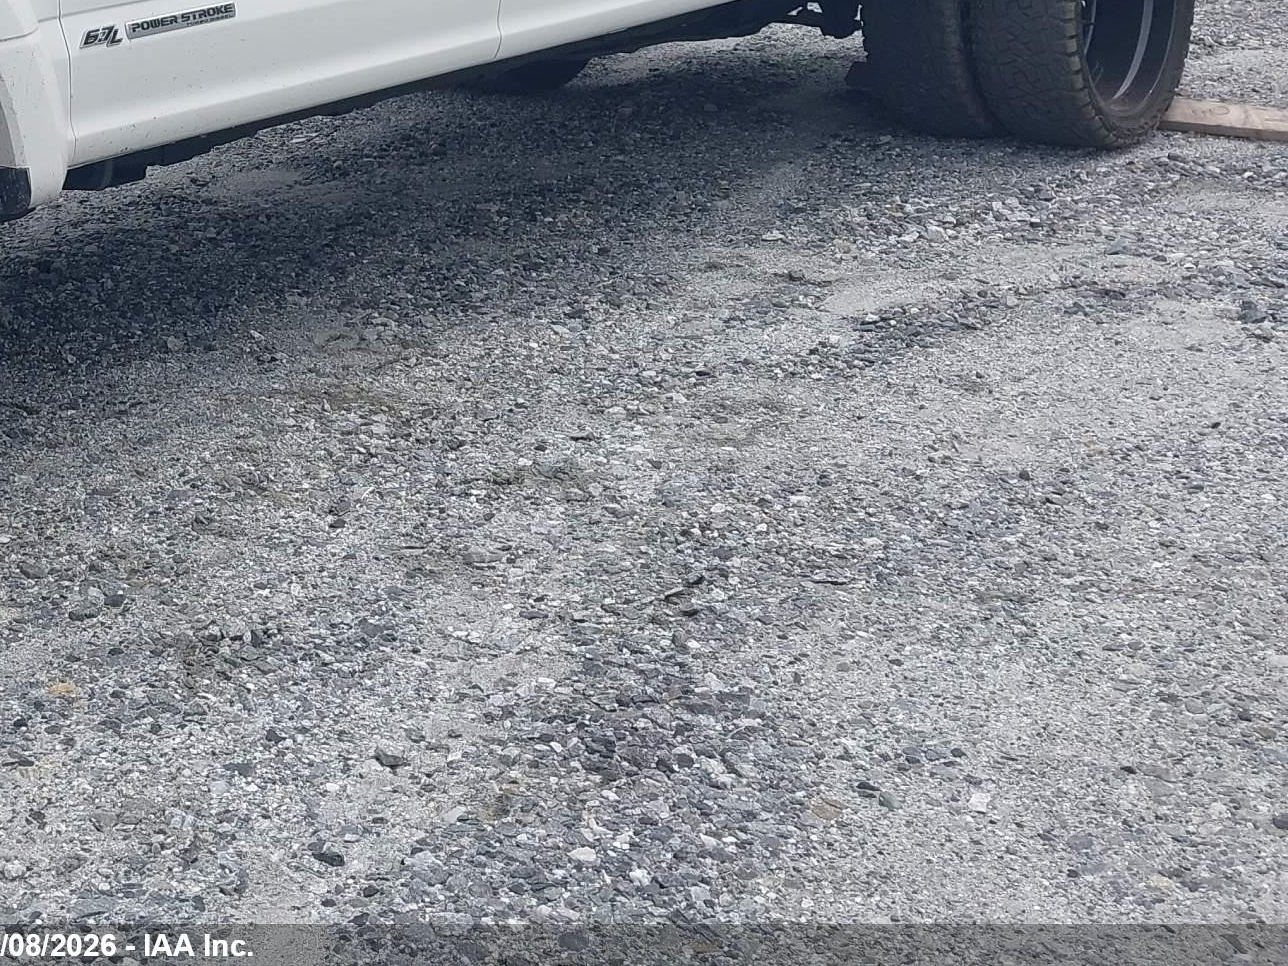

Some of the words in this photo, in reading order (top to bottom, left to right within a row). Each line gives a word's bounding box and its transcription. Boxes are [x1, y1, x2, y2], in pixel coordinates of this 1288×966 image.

[81, 24, 124, 48] 6.7L
[130, 15, 180, 33] POWER
[180, 2, 235, 23] STROKE
